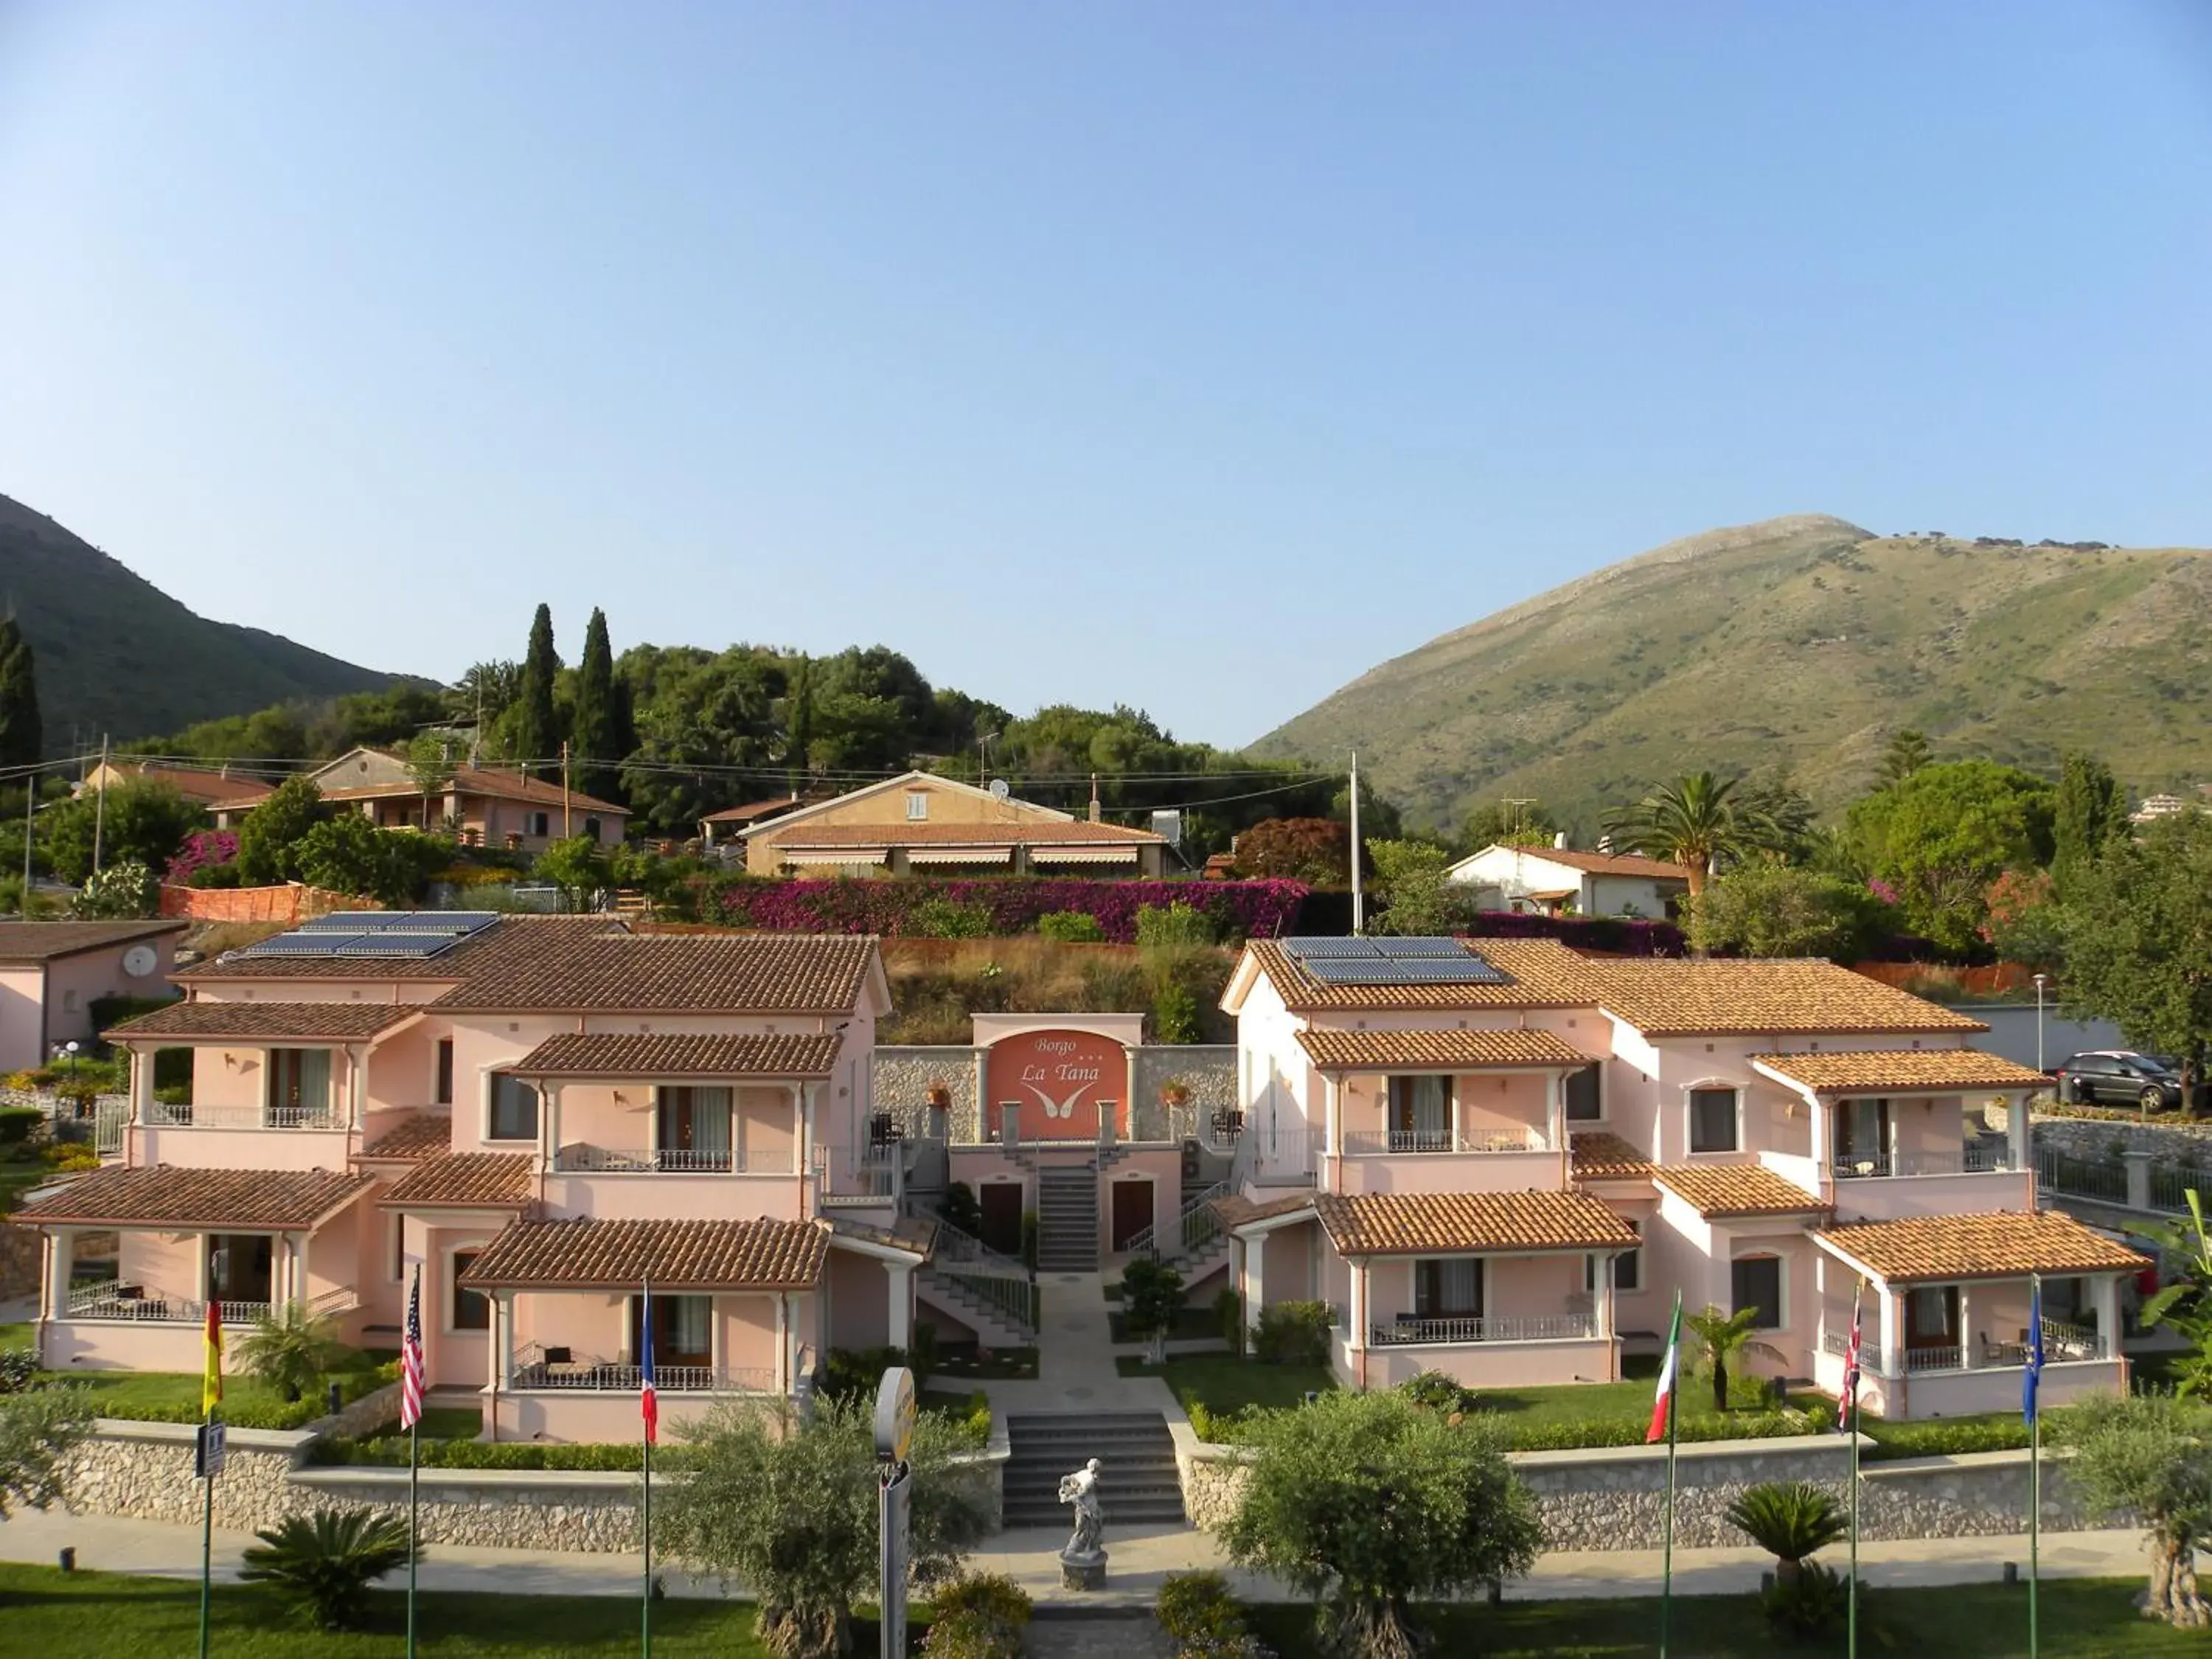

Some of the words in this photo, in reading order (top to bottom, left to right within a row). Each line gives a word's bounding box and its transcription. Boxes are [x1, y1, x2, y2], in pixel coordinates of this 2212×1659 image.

[1035, 1037, 1076, 1055] Borgo
[1021, 1064, 1045, 1080] La
[1056, 1063, 1099, 1080] Tana
